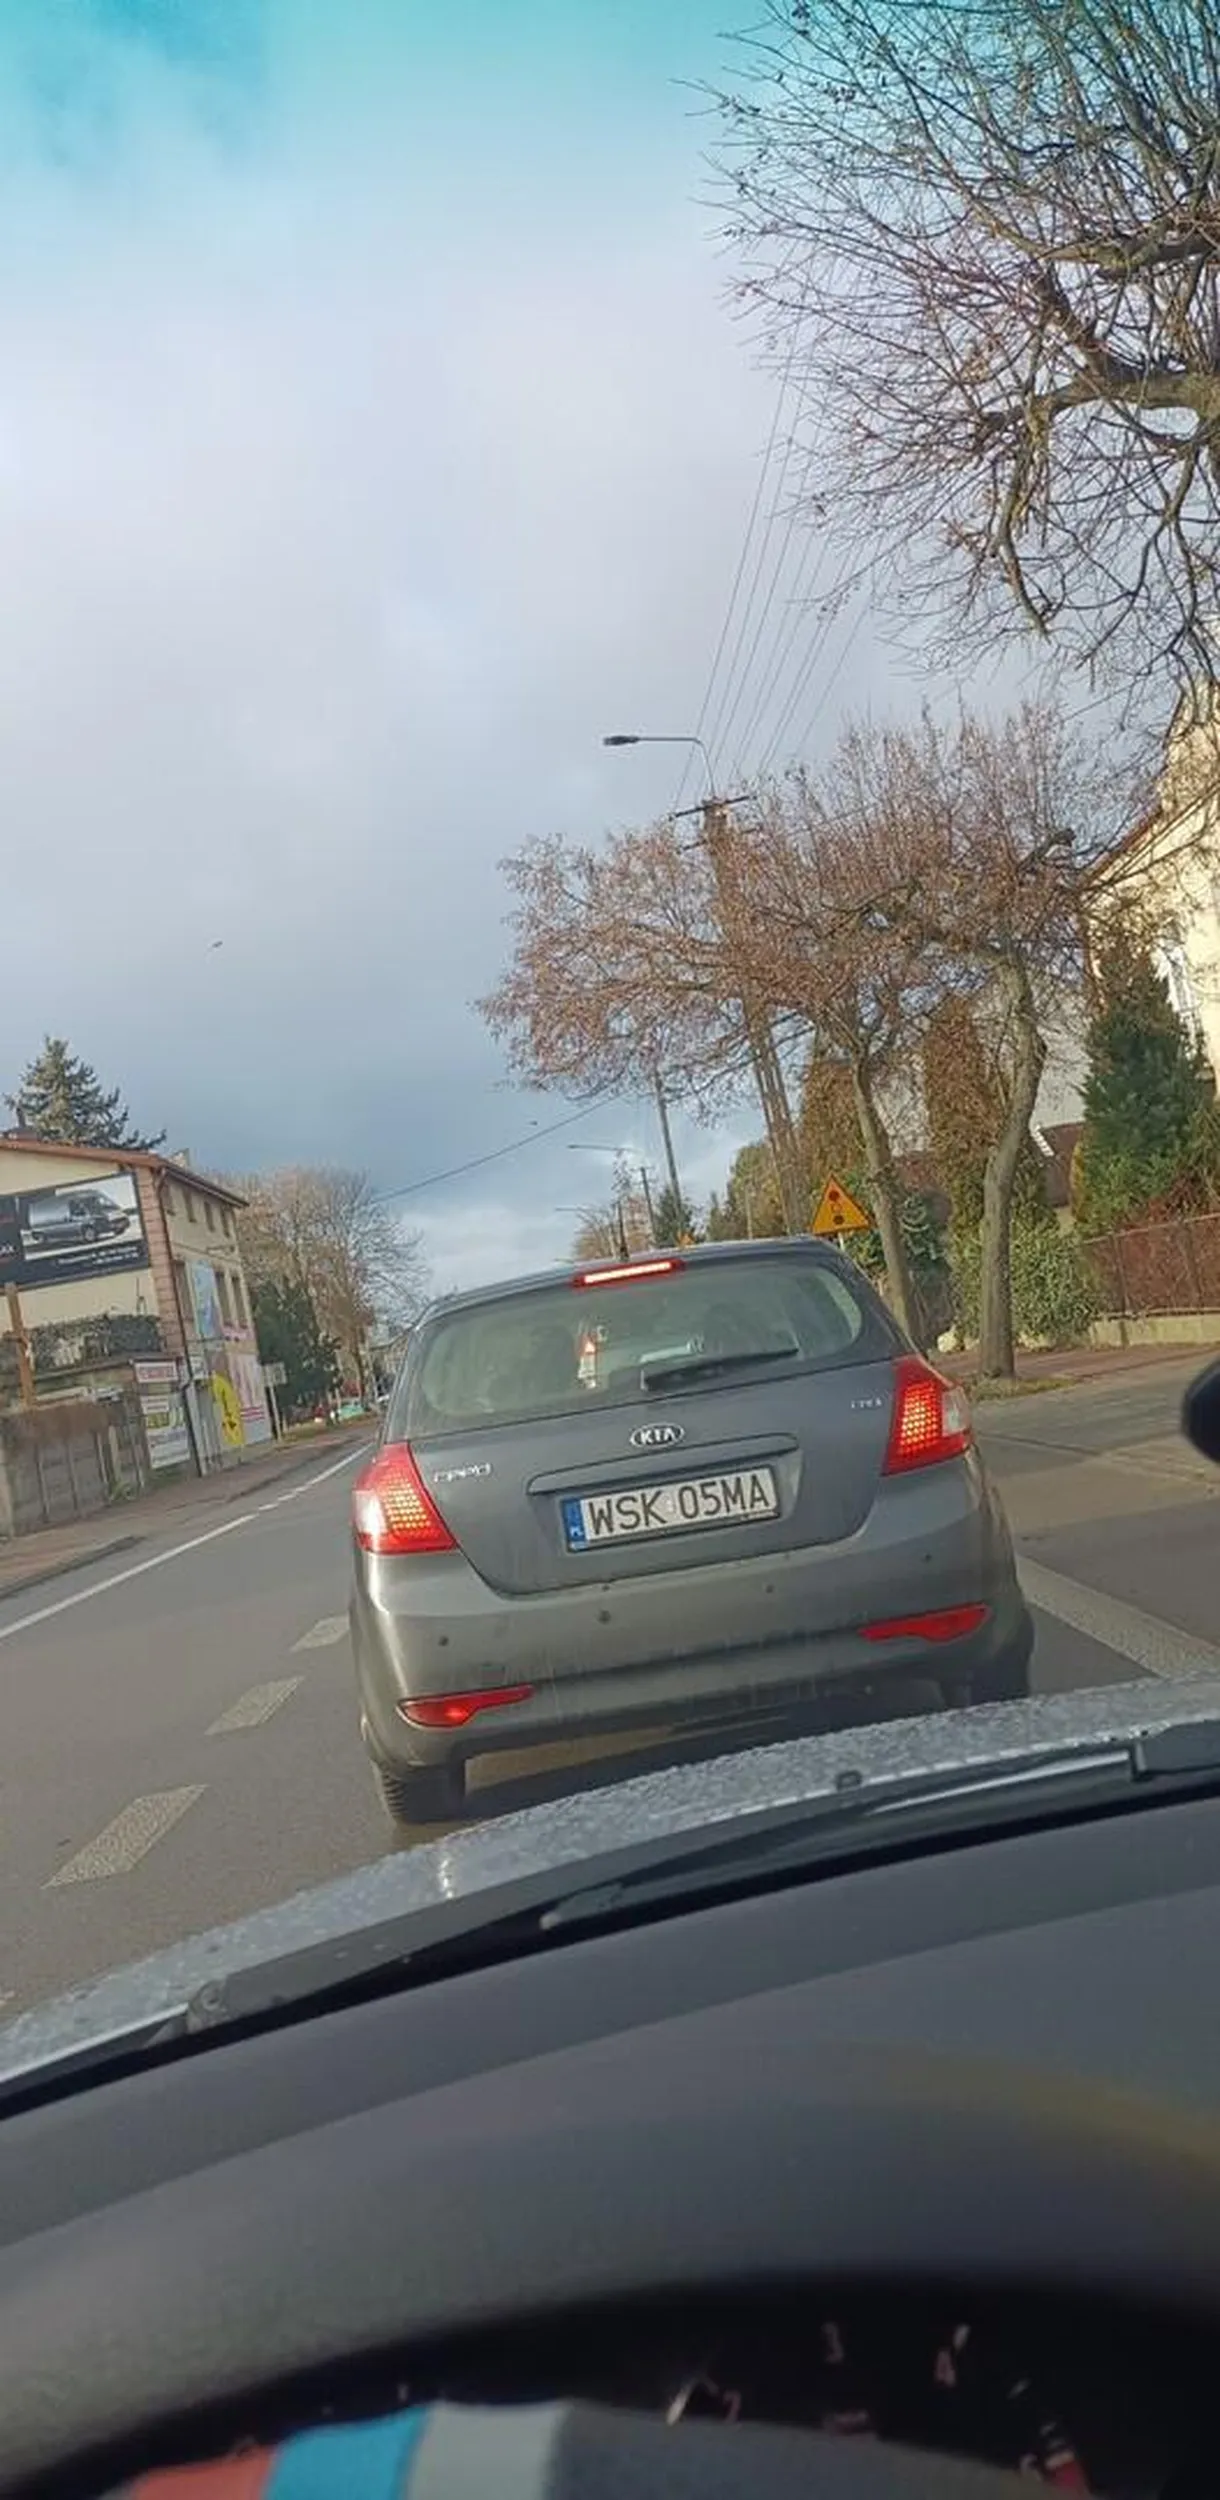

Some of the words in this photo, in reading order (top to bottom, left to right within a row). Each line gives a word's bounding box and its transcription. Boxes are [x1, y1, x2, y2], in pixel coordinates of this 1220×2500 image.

[640, 1427, 678, 1445] KIA
[588, 1489, 667, 1535] WSK
[677, 1474, 770, 1520] 05MA
